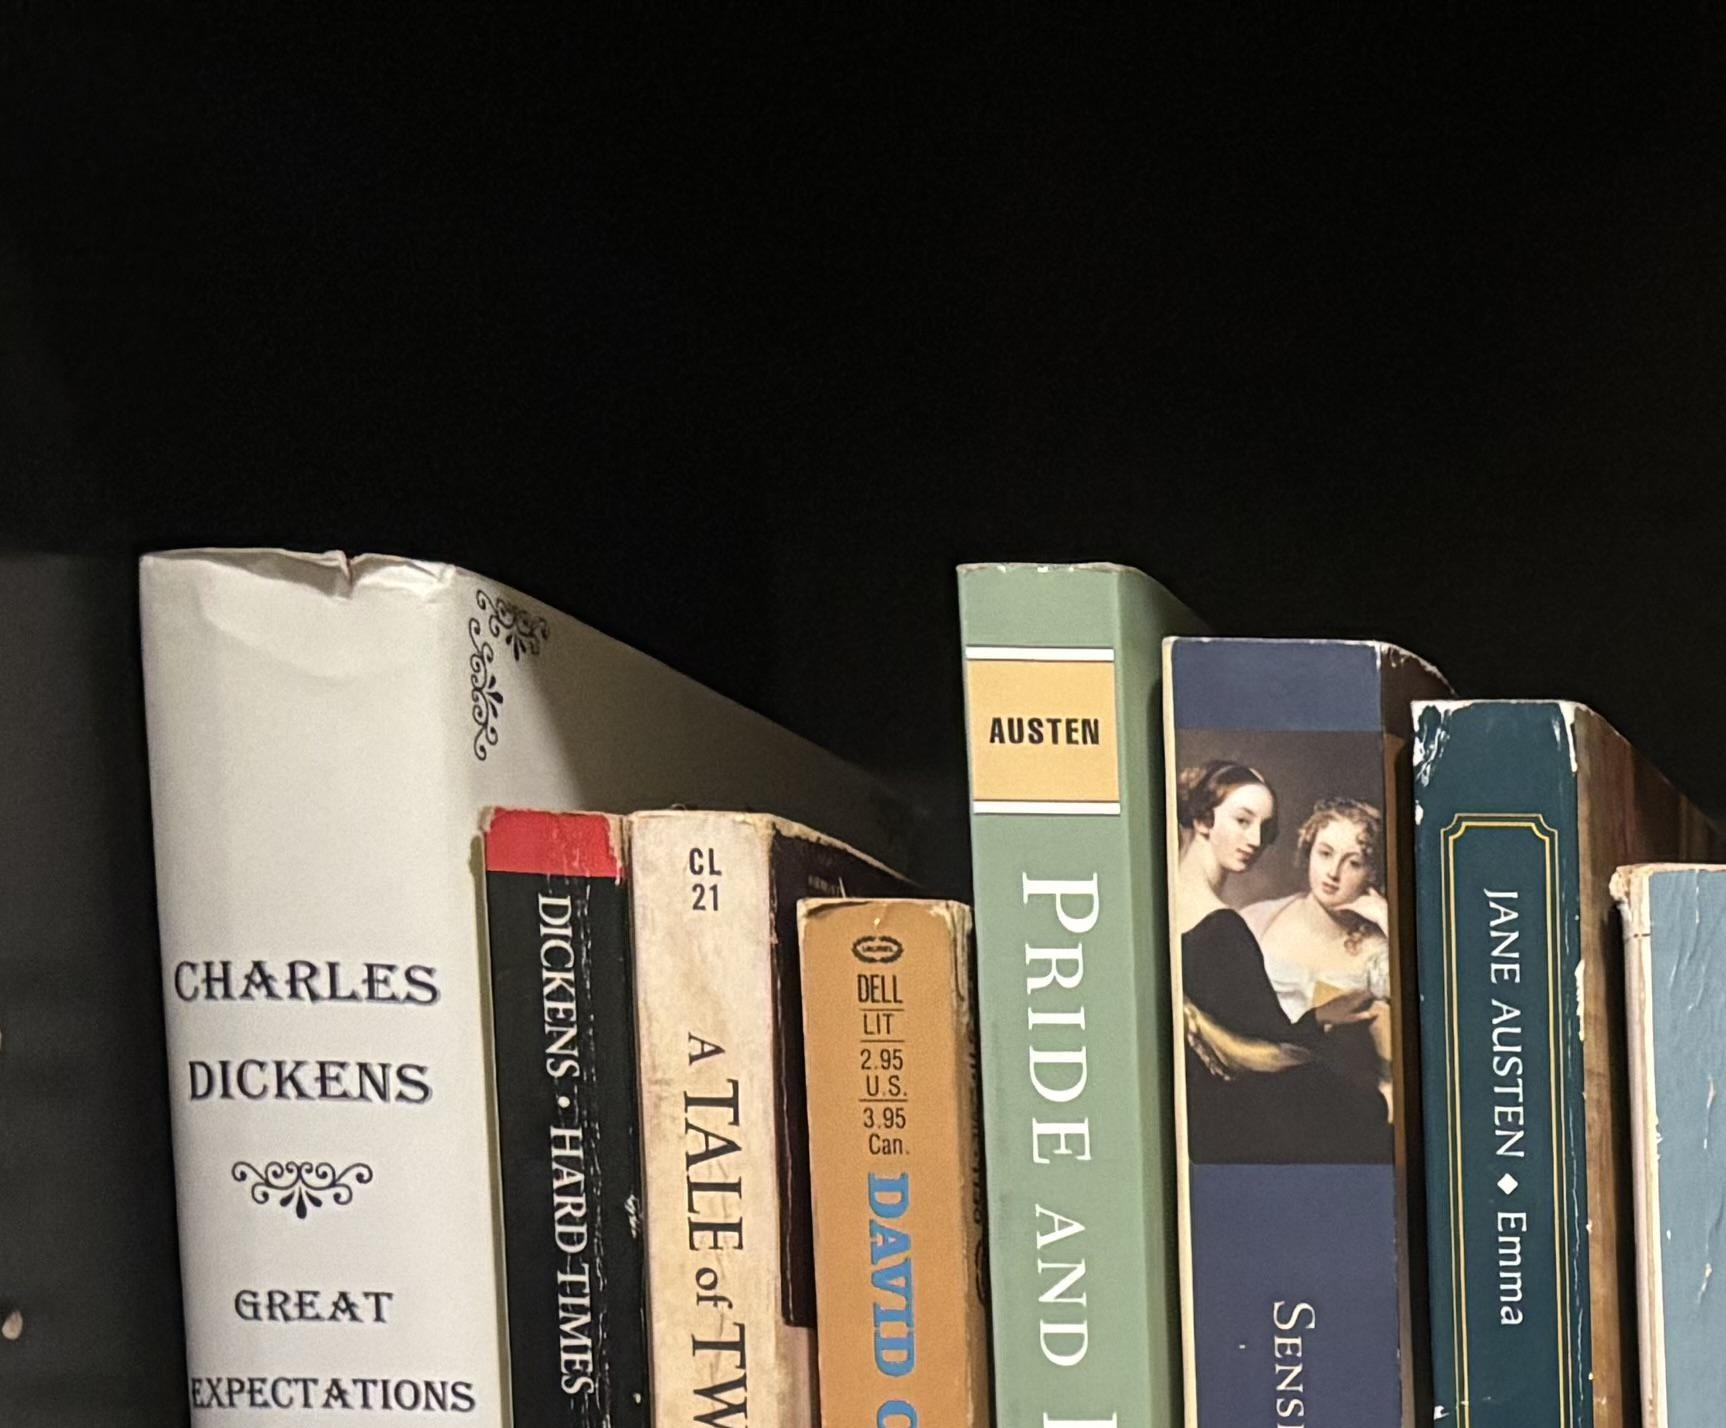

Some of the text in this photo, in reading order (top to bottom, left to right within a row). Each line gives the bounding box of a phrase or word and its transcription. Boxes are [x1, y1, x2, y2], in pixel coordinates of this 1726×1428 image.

[989, 716, 1100, 746] AUSTEN
[688, 846, 723, 877] CL
[691, 882, 719, 912] 21
[173, 959, 441, 1007] CHARLES
[857, 974, 904, 1004] DELL
[863, 1012, 895, 1036] LIT
[1021, 871, 1100, 1165] PRIDE
[687, 1032, 726, 1066] A
[860, 1048, 904, 1071] 2.95
[188, 1058, 433, 1105] DICKENS
[866, 1074, 908, 1097] U.S.
[863, 1106, 907, 1130] 3.95
[1483, 888, 1528, 1325] JANE AUSTEN Emma
[537, 893, 596, 1395] DICKENS HARD TIMES
[868, 1132, 910, 1156] Can.
[682, 1078, 744, 1252] TALE
[694, 1266, 734, 1310] of
[867, 1172, 917, 1378] DAVID
[1034, 1203, 1089, 1367] AND
[233, 1289, 394, 1324] GREAT
[192, 1377, 475, 1411] EXPECTATIONS
